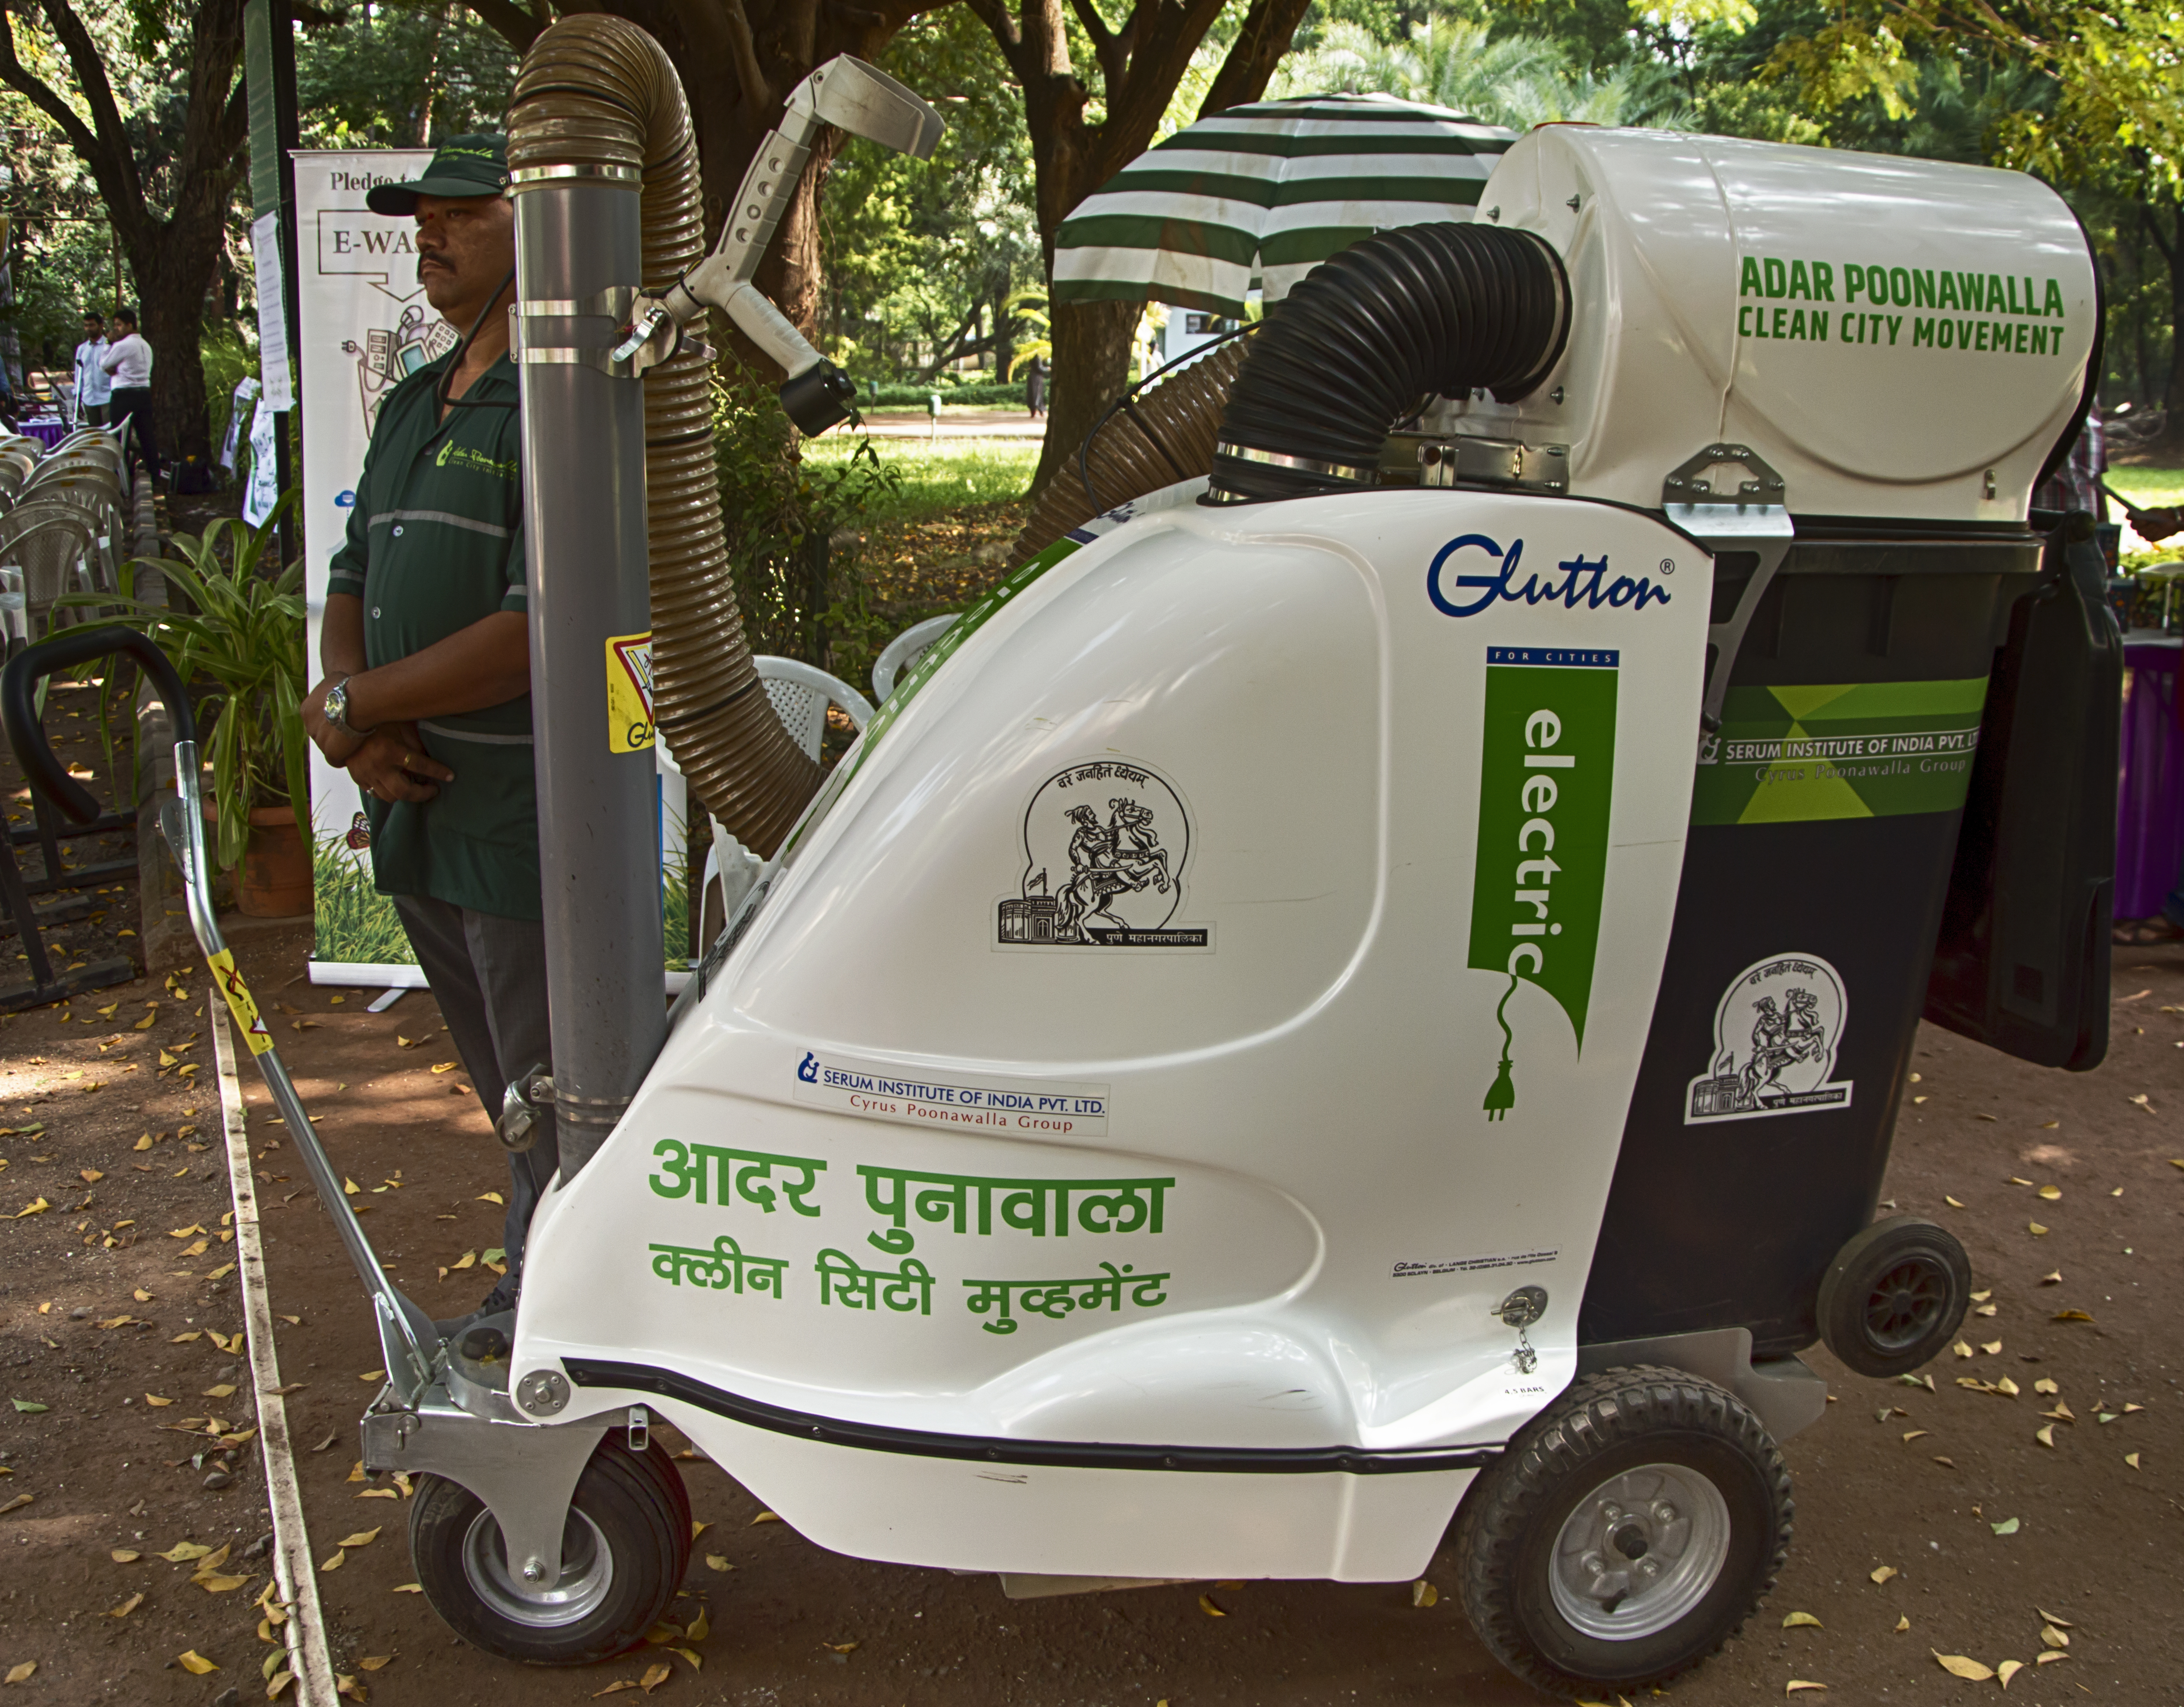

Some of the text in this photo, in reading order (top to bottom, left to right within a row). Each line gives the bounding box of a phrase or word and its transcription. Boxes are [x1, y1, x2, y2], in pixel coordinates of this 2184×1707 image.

[400, 173, 416, 183] t
[333, 231, 419, 254] E-WA
[1740, 256, 2065, 318] ADAR POONAWALLA
[1739, 305, 2065, 355] CLEAN CITY MOVEMENT
[1495, 651, 1611, 663] FOR CITIES
[1726, 743, 1781, 759] SERUM
[1787, 739, 1864, 758] INSTITUTE
[1868, 738, 1888, 753] OF
[1892, 736, 1934, 752] INDIA
[1939, 735, 1964, 750] PVT.
[1755, 758, 1966, 785] Cyrus Poonawalla Group
[1508, 709, 1575, 976] electric
[1106, 932, 1202, 944] पुणे महानगरपालिका
[824, 1070, 1106, 1114] SERUM INSTITUTE OF INDIA PVT. LTD.
[850, 1095, 1073, 1133] Cyrus Poonawalla Group
[648, 1138, 1176, 1255] आदर पुनावाला
[648, 1235, 1170, 1335] क्लीन सिटी मुव्हमेंट
